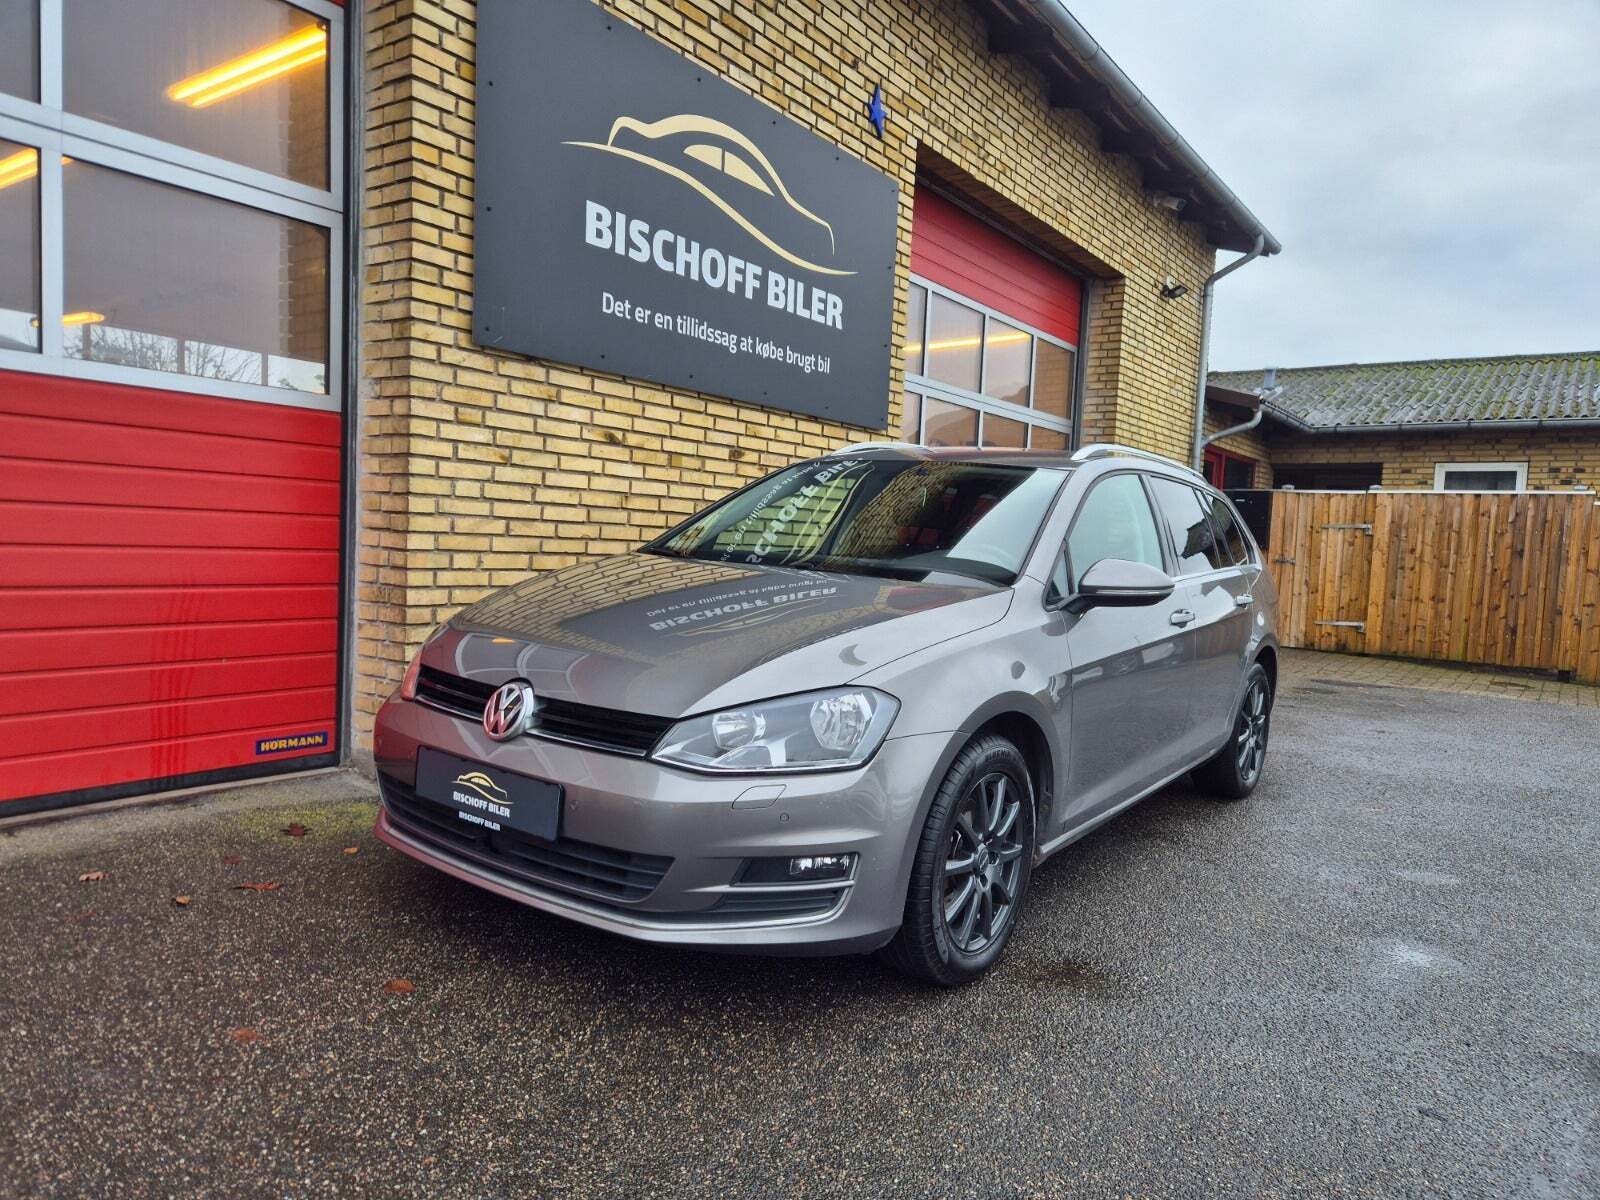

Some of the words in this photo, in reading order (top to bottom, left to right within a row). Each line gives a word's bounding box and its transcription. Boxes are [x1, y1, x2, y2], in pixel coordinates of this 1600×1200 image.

[585, 199, 762, 300] BISCHOFF
[767, 270, 843, 330] BILER
[602, 291, 631, 320] Det
[634, 307, 651, 325] er
[655, 313, 673, 331] en
[676, 314, 737, 354] tillidssag
[740, 337, 753, 353] at
[755, 337, 784, 361] købe
[786, 345, 816, 374] brugt
[817, 355, 830, 374] bil
[453, 790, 488, 810] BISCHOFF
[488, 802, 510, 818] BILER
